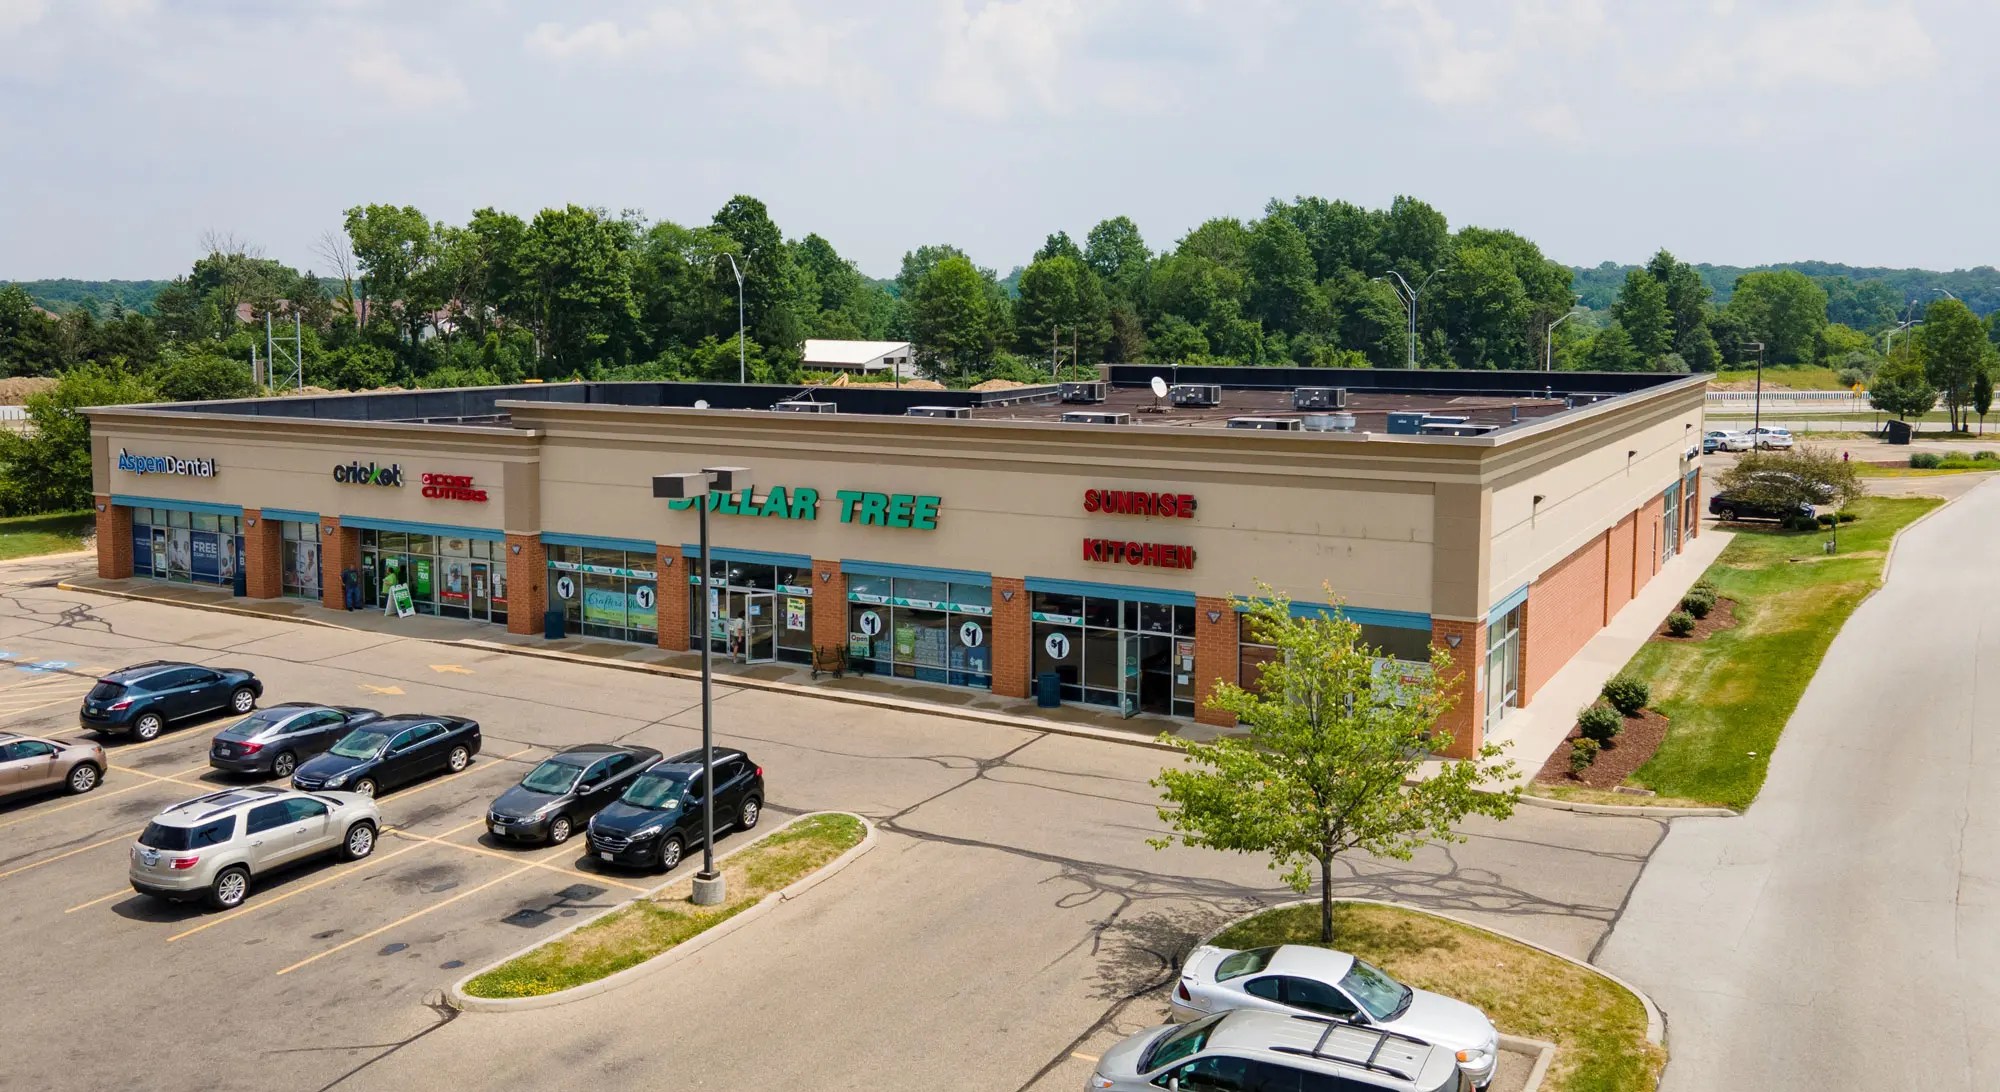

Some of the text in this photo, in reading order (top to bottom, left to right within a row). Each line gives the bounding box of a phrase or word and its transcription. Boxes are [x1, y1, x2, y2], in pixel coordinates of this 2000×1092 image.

[118, 447, 215, 477] AspenDental
[333, 461, 403, 487] cricket
[434, 474, 474, 488] COST
[421, 486, 488, 502] CUTTERS
[1083, 489, 1195, 518] SUNRISE
[836, 490, 941, 530] TREE
[193, 541, 217, 554] FREE
[1083, 538, 1195, 570] KITCHEN
[561, 581, 570, 598] $1
[640, 590, 650, 608] $1
[864, 616, 876, 634] $1
[965, 627, 977, 646] $1
[1050, 638, 1063, 658] $1
